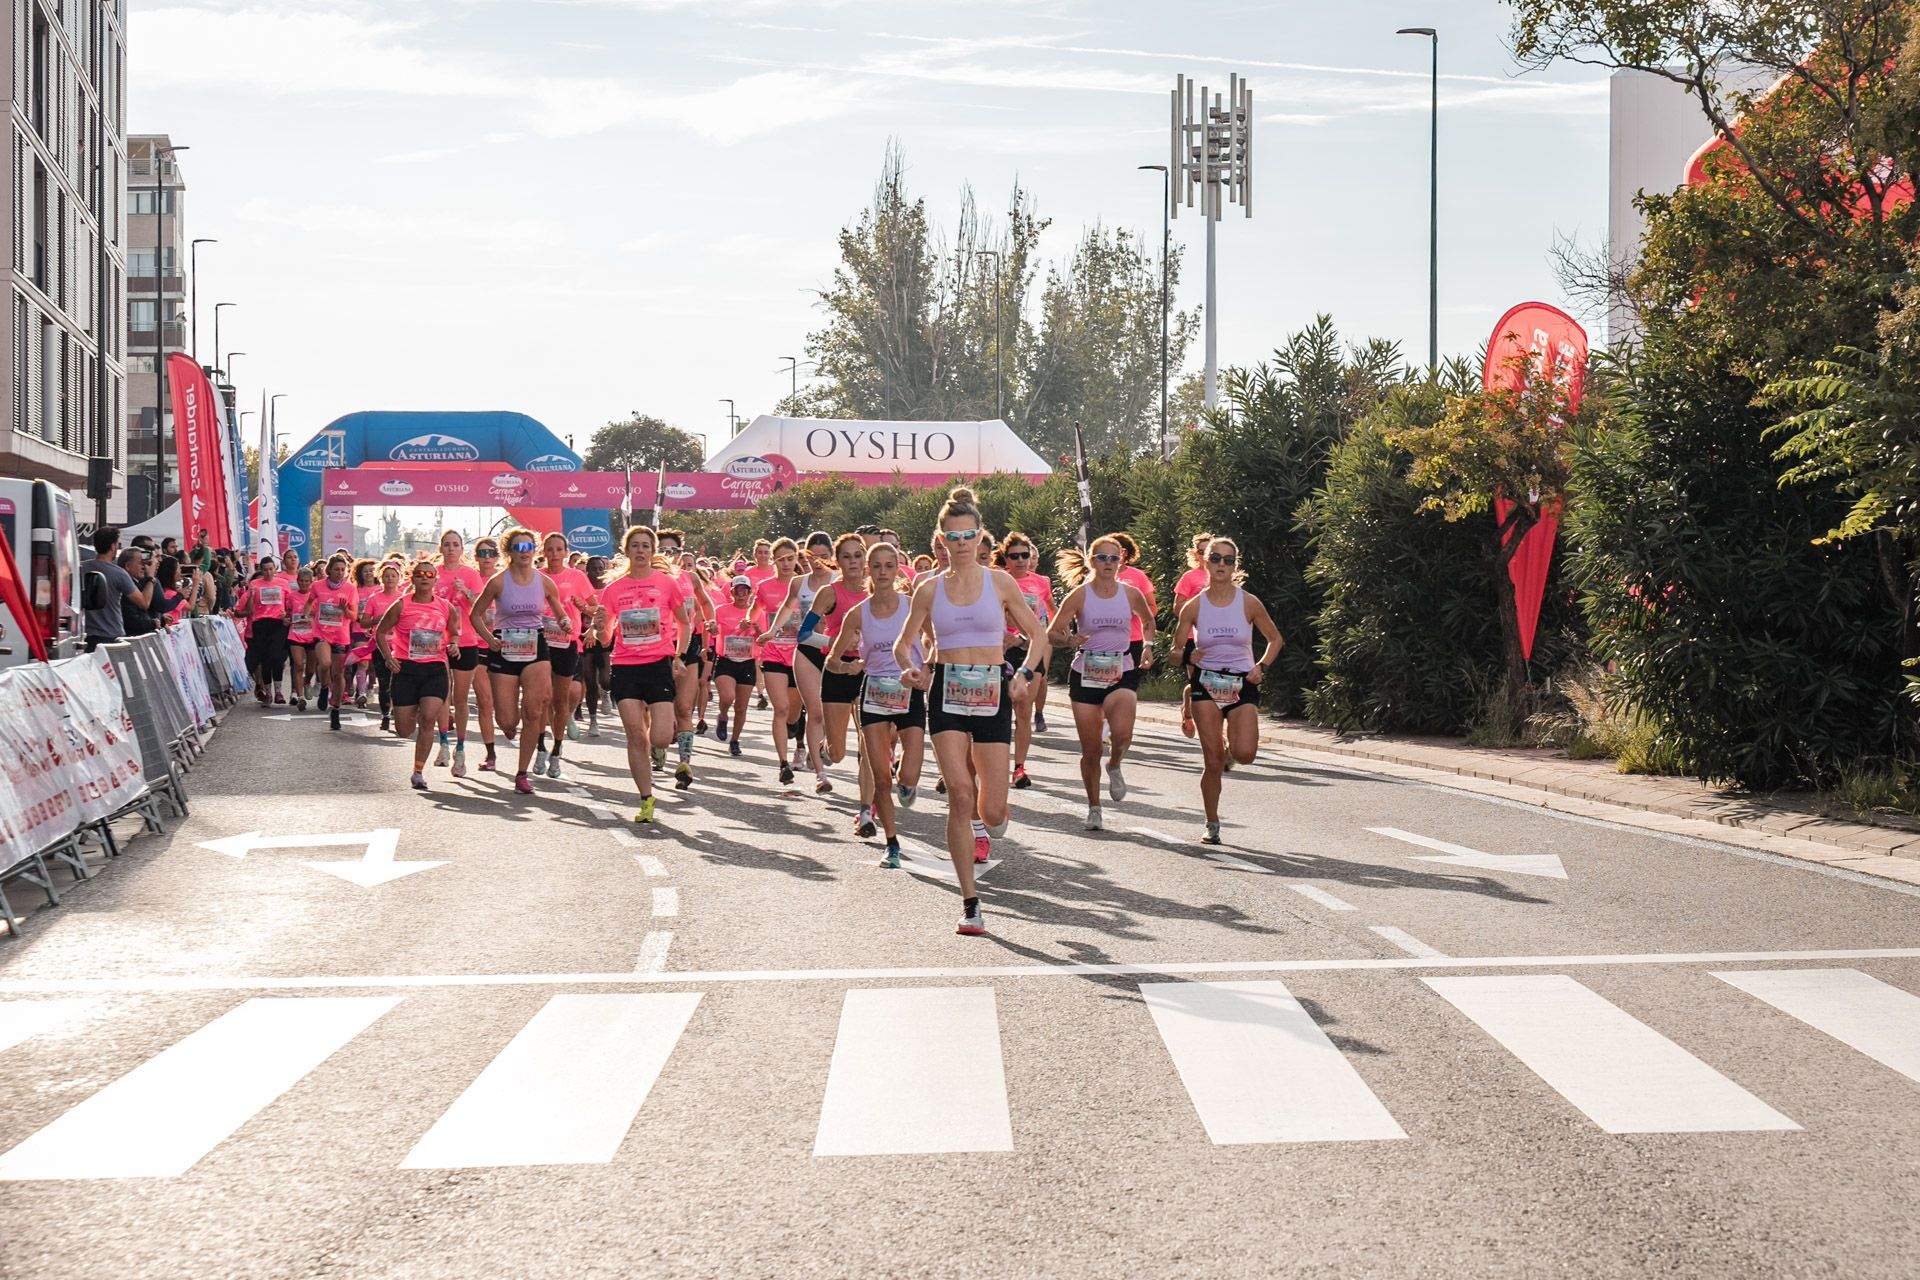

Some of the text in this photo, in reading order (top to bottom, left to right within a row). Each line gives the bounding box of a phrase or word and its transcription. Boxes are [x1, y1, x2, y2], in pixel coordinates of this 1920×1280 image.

[806, 428, 955, 461] OYSHO
[397, 449, 472, 460] ASTURIANA
[730, 464, 771, 473] ASTURIANA
[434, 484, 469, 492] OYSHO
[721, 477, 762, 490] Carrera
[607, 486, 642, 495] OYSO
[1208, 627, 1239, 635] OYSHO
